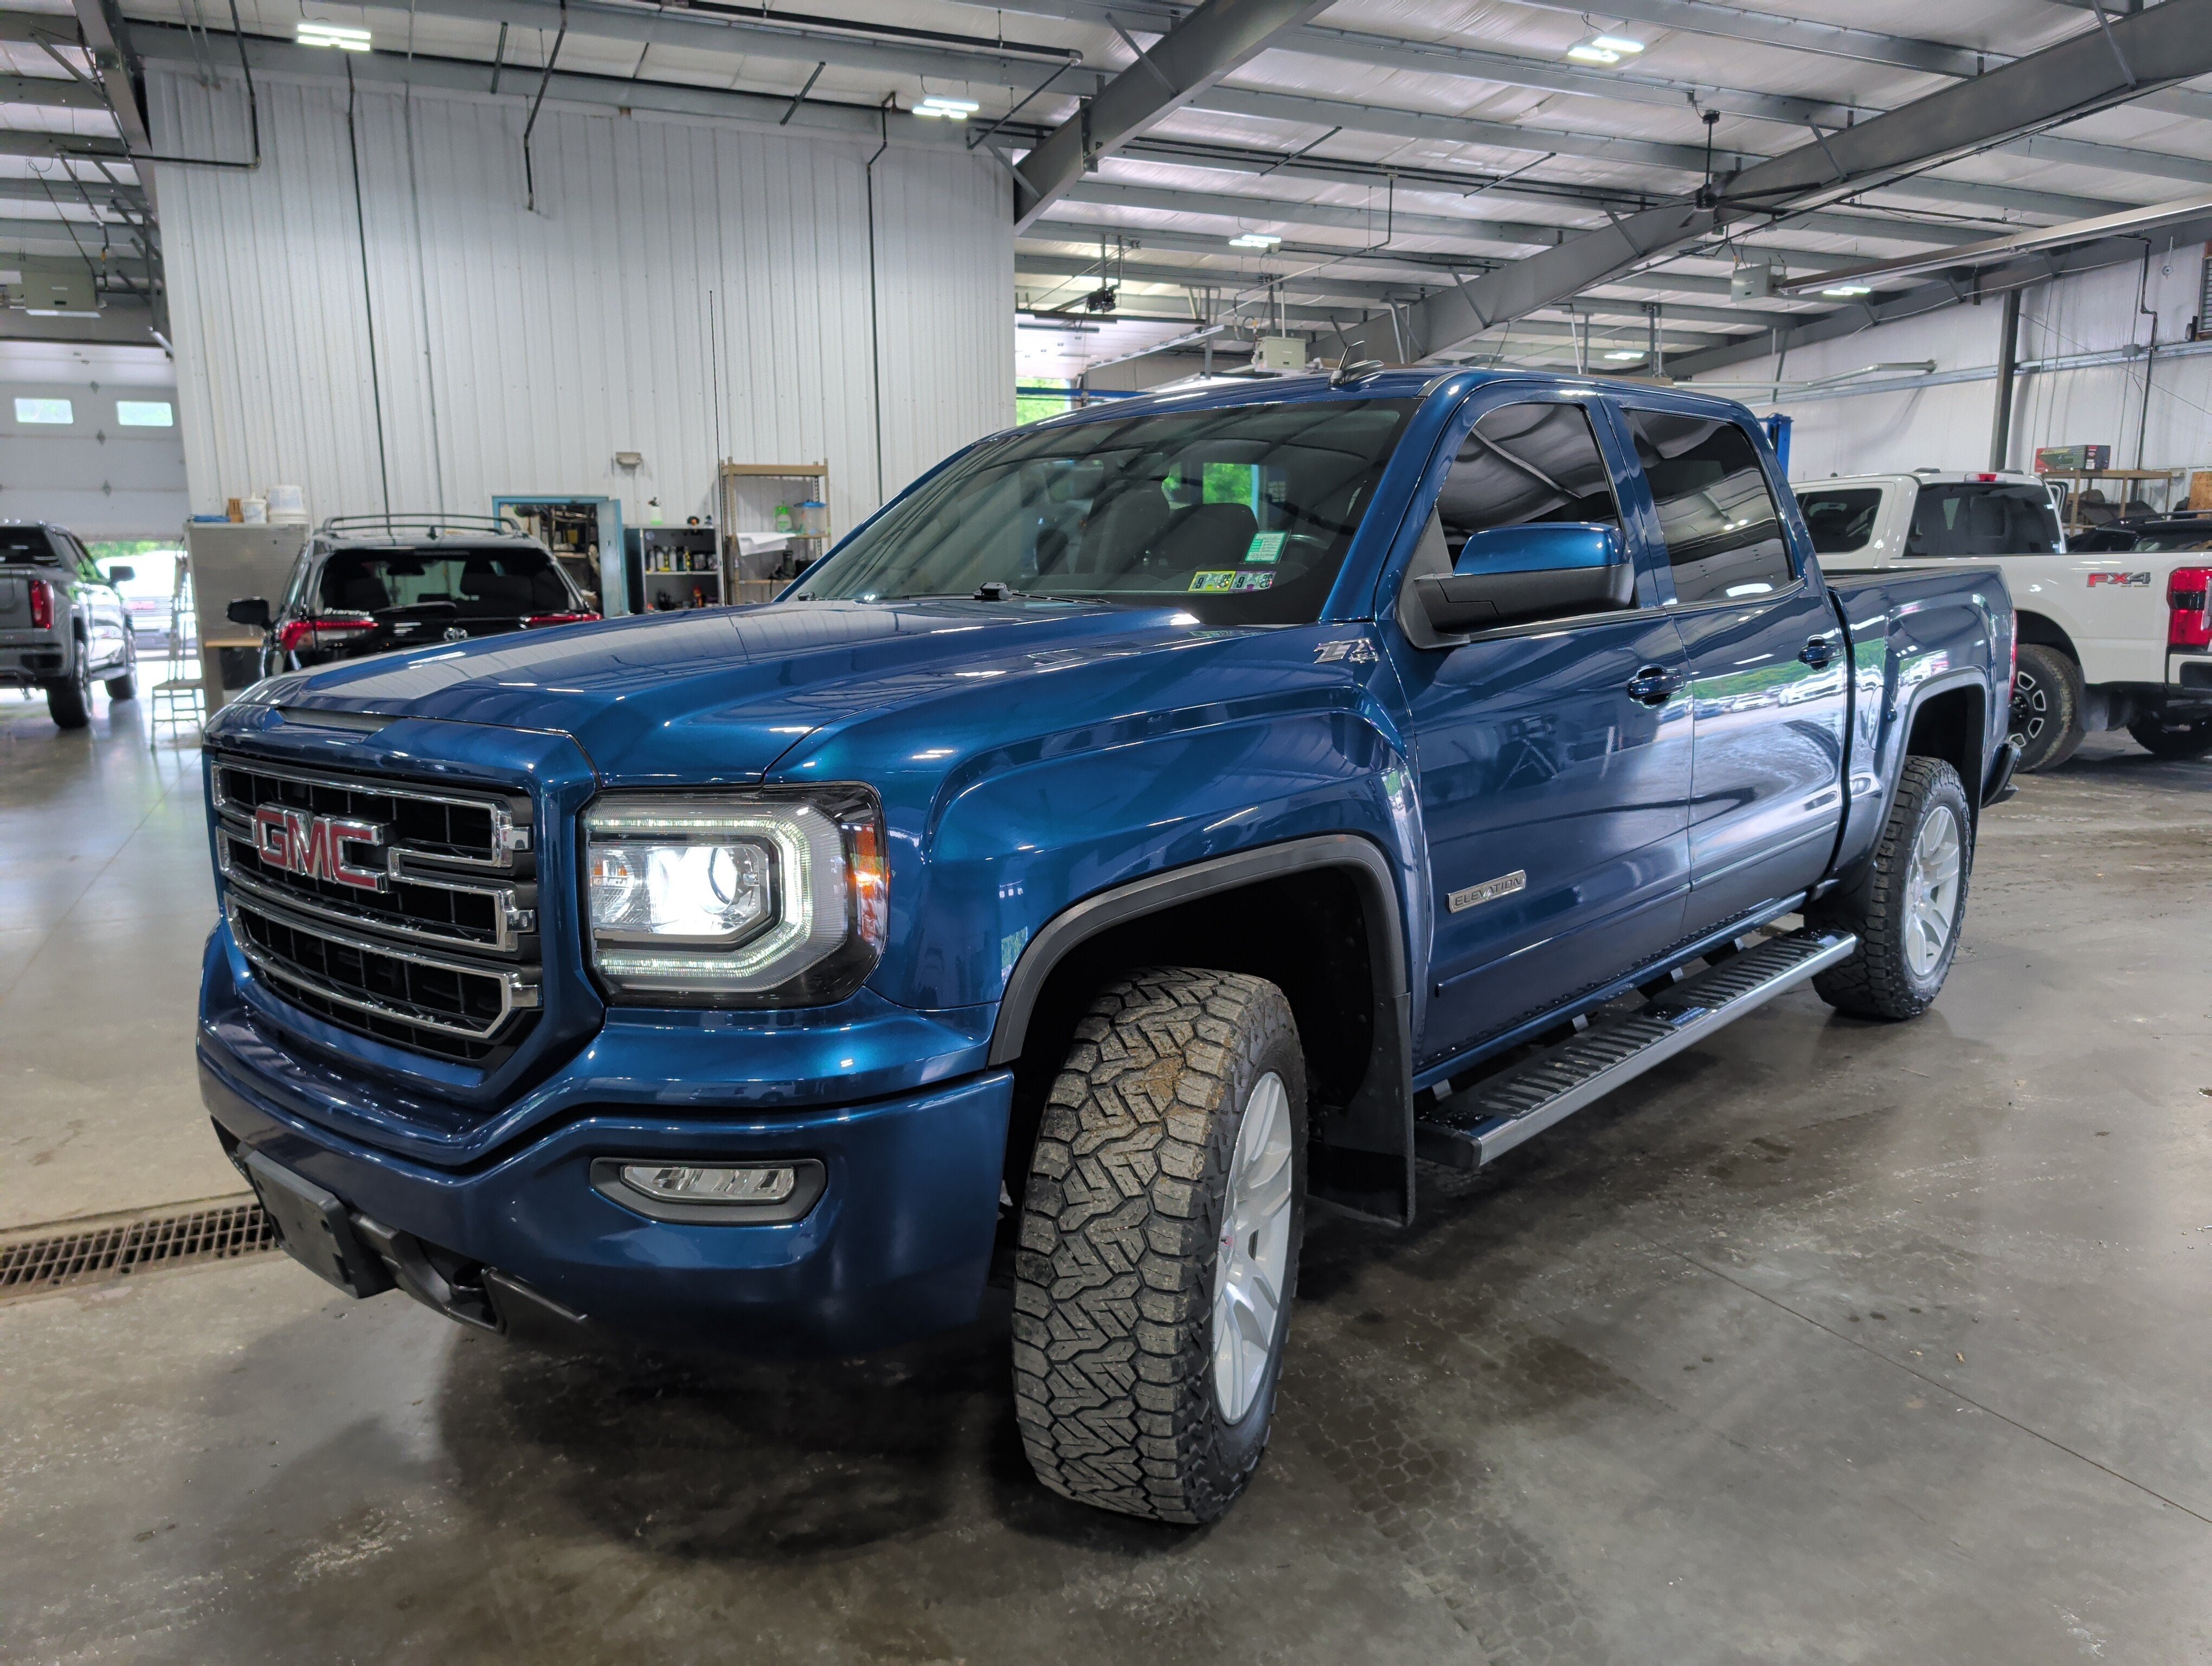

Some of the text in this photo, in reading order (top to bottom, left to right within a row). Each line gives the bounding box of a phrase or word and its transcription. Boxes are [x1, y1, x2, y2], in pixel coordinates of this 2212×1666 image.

[1195, 577, 1204, 588] 9
[1236, 576, 1245, 588] 9
[2087, 572, 2151, 587] FX4
[256, 803, 388, 894] GMC
[1455, 876, 1522, 906] ELEVATION
